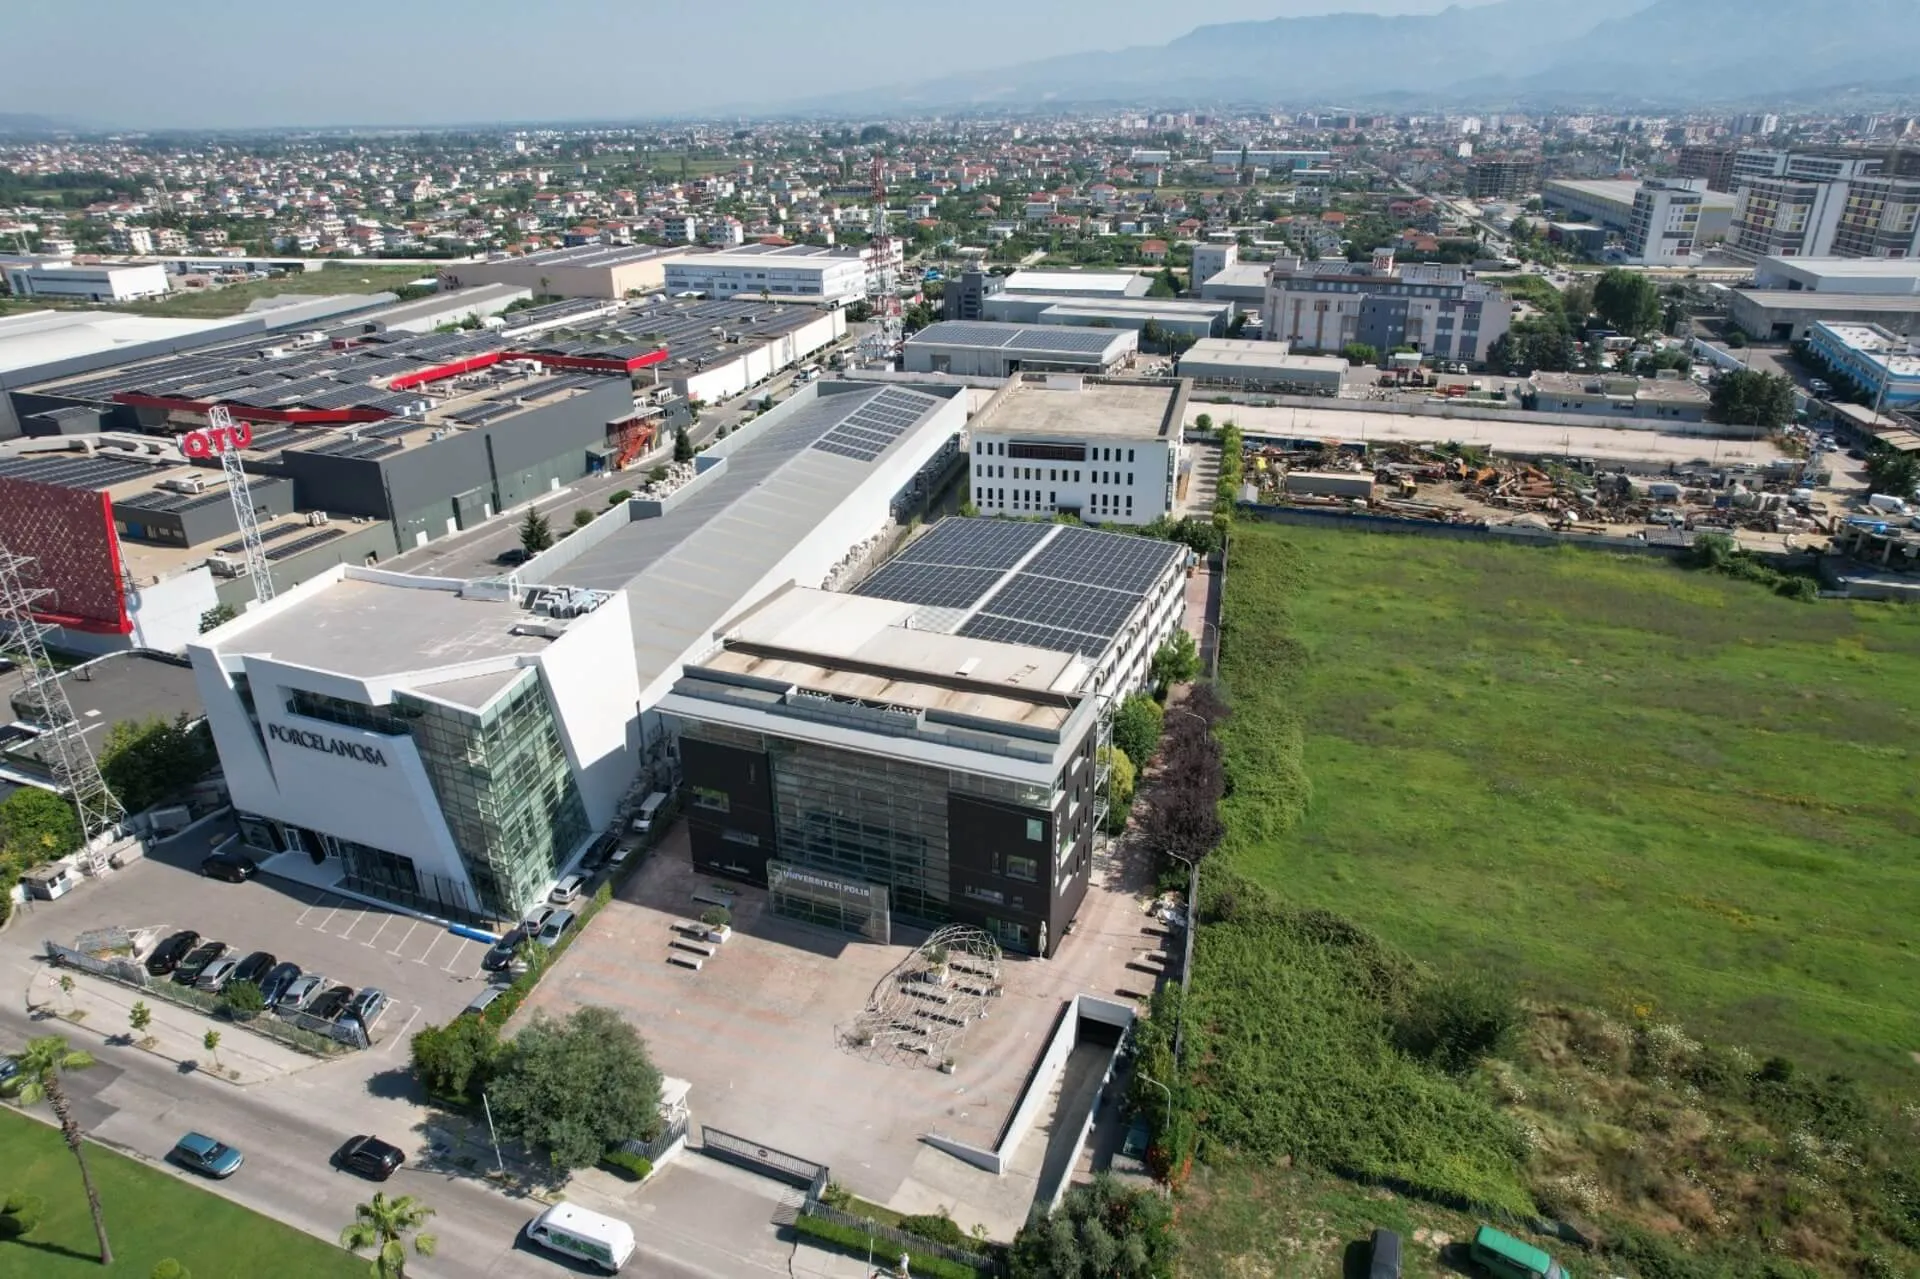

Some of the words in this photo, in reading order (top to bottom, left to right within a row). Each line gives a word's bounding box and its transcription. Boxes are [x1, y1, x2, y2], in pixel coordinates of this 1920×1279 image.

[183, 421, 253, 460] QTU
[268, 723, 388, 767] PORCELANOSA
[783, 870, 842, 889] UNIVERSITETI
[843, 885, 870, 897] POLIS
